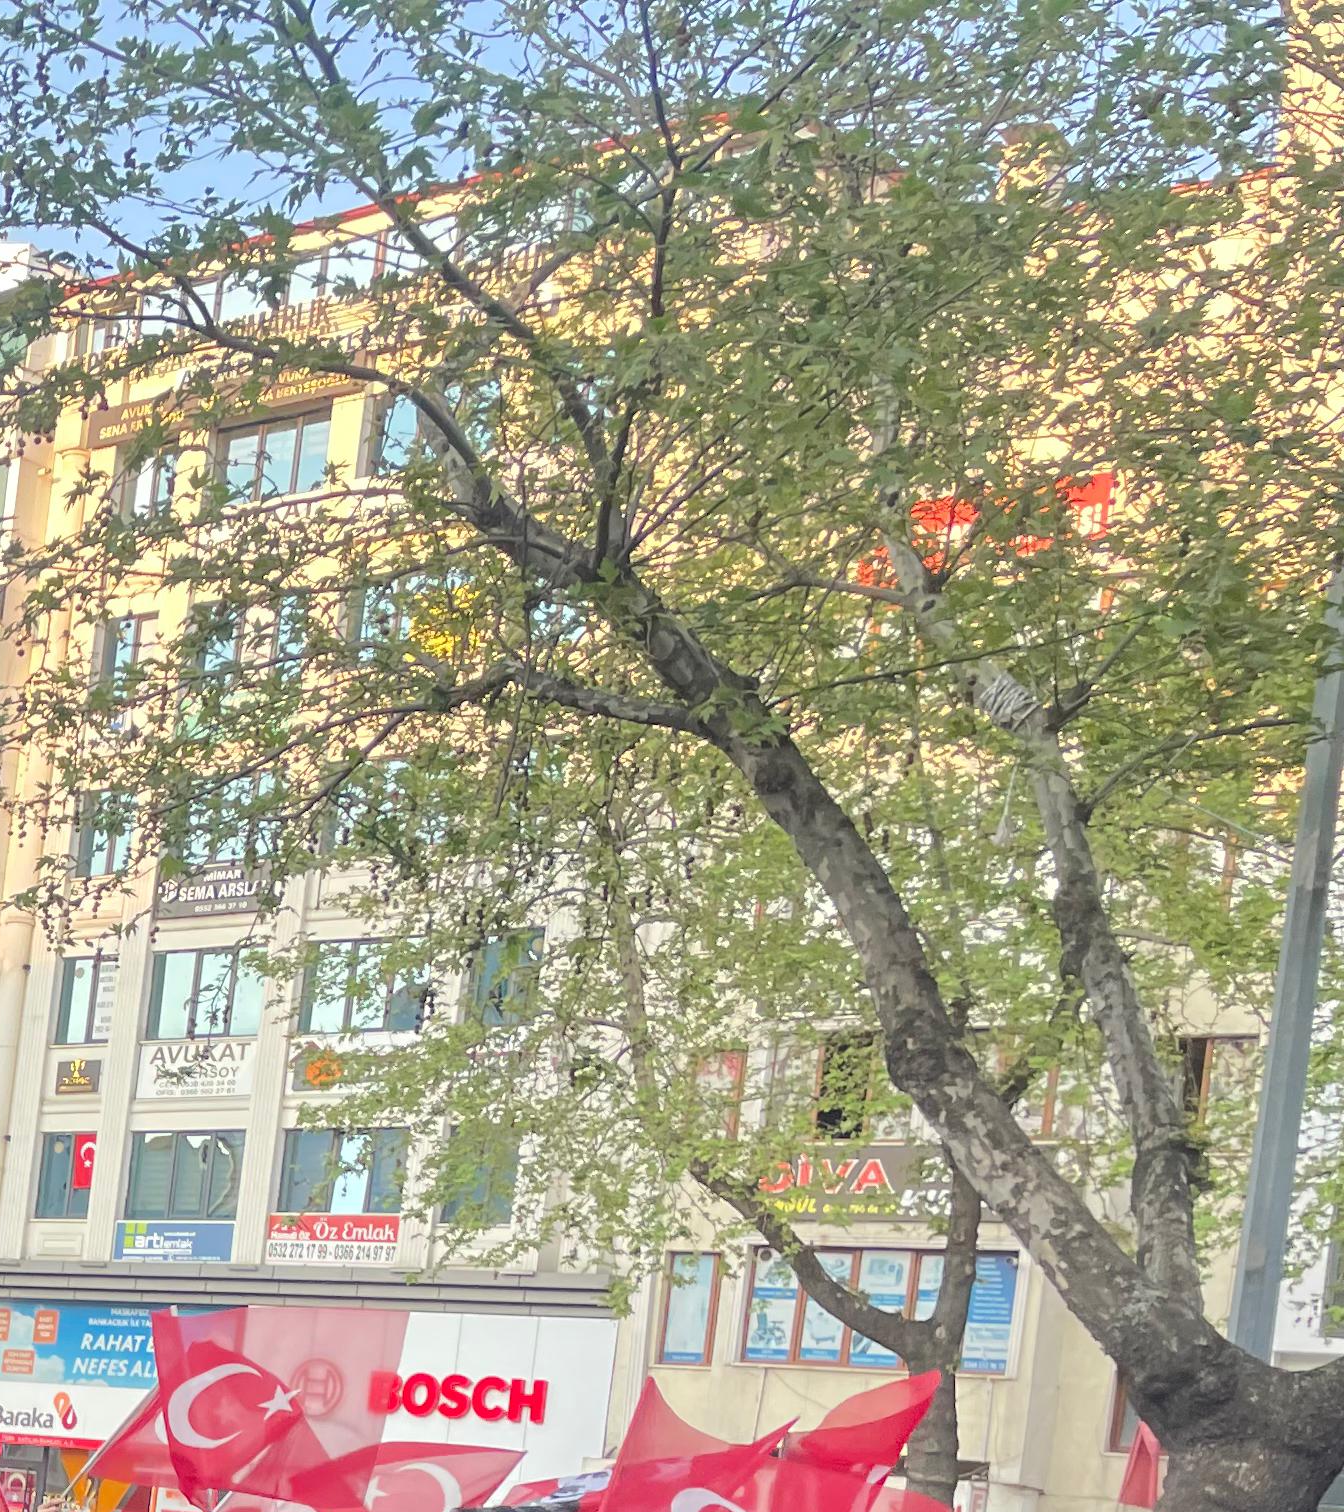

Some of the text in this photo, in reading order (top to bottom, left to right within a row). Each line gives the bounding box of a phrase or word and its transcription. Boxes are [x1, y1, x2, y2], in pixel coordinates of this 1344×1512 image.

[178, 884, 215, 902] SEMA
[149, 1043, 252, 1064] AVUKAT
[313, 1216, 395, 1241] Öz Emlak
[268, 1243, 288, 1258] 0532
[289, 1244, 305, 1258] 272
[306, 1244, 316, 1258] 17
[355, 1246, 371, 1260] 214
[372, 1246, 384, 1261] 97
[385, 1246, 397, 1261] 97
[88, 1317, 129, 1327] BANKACILIK
[80, 1332, 145, 1353] RAHAT
[72, 1356, 128, 1376] NEFES
[368, 1370, 549, 1424] BOSCH
